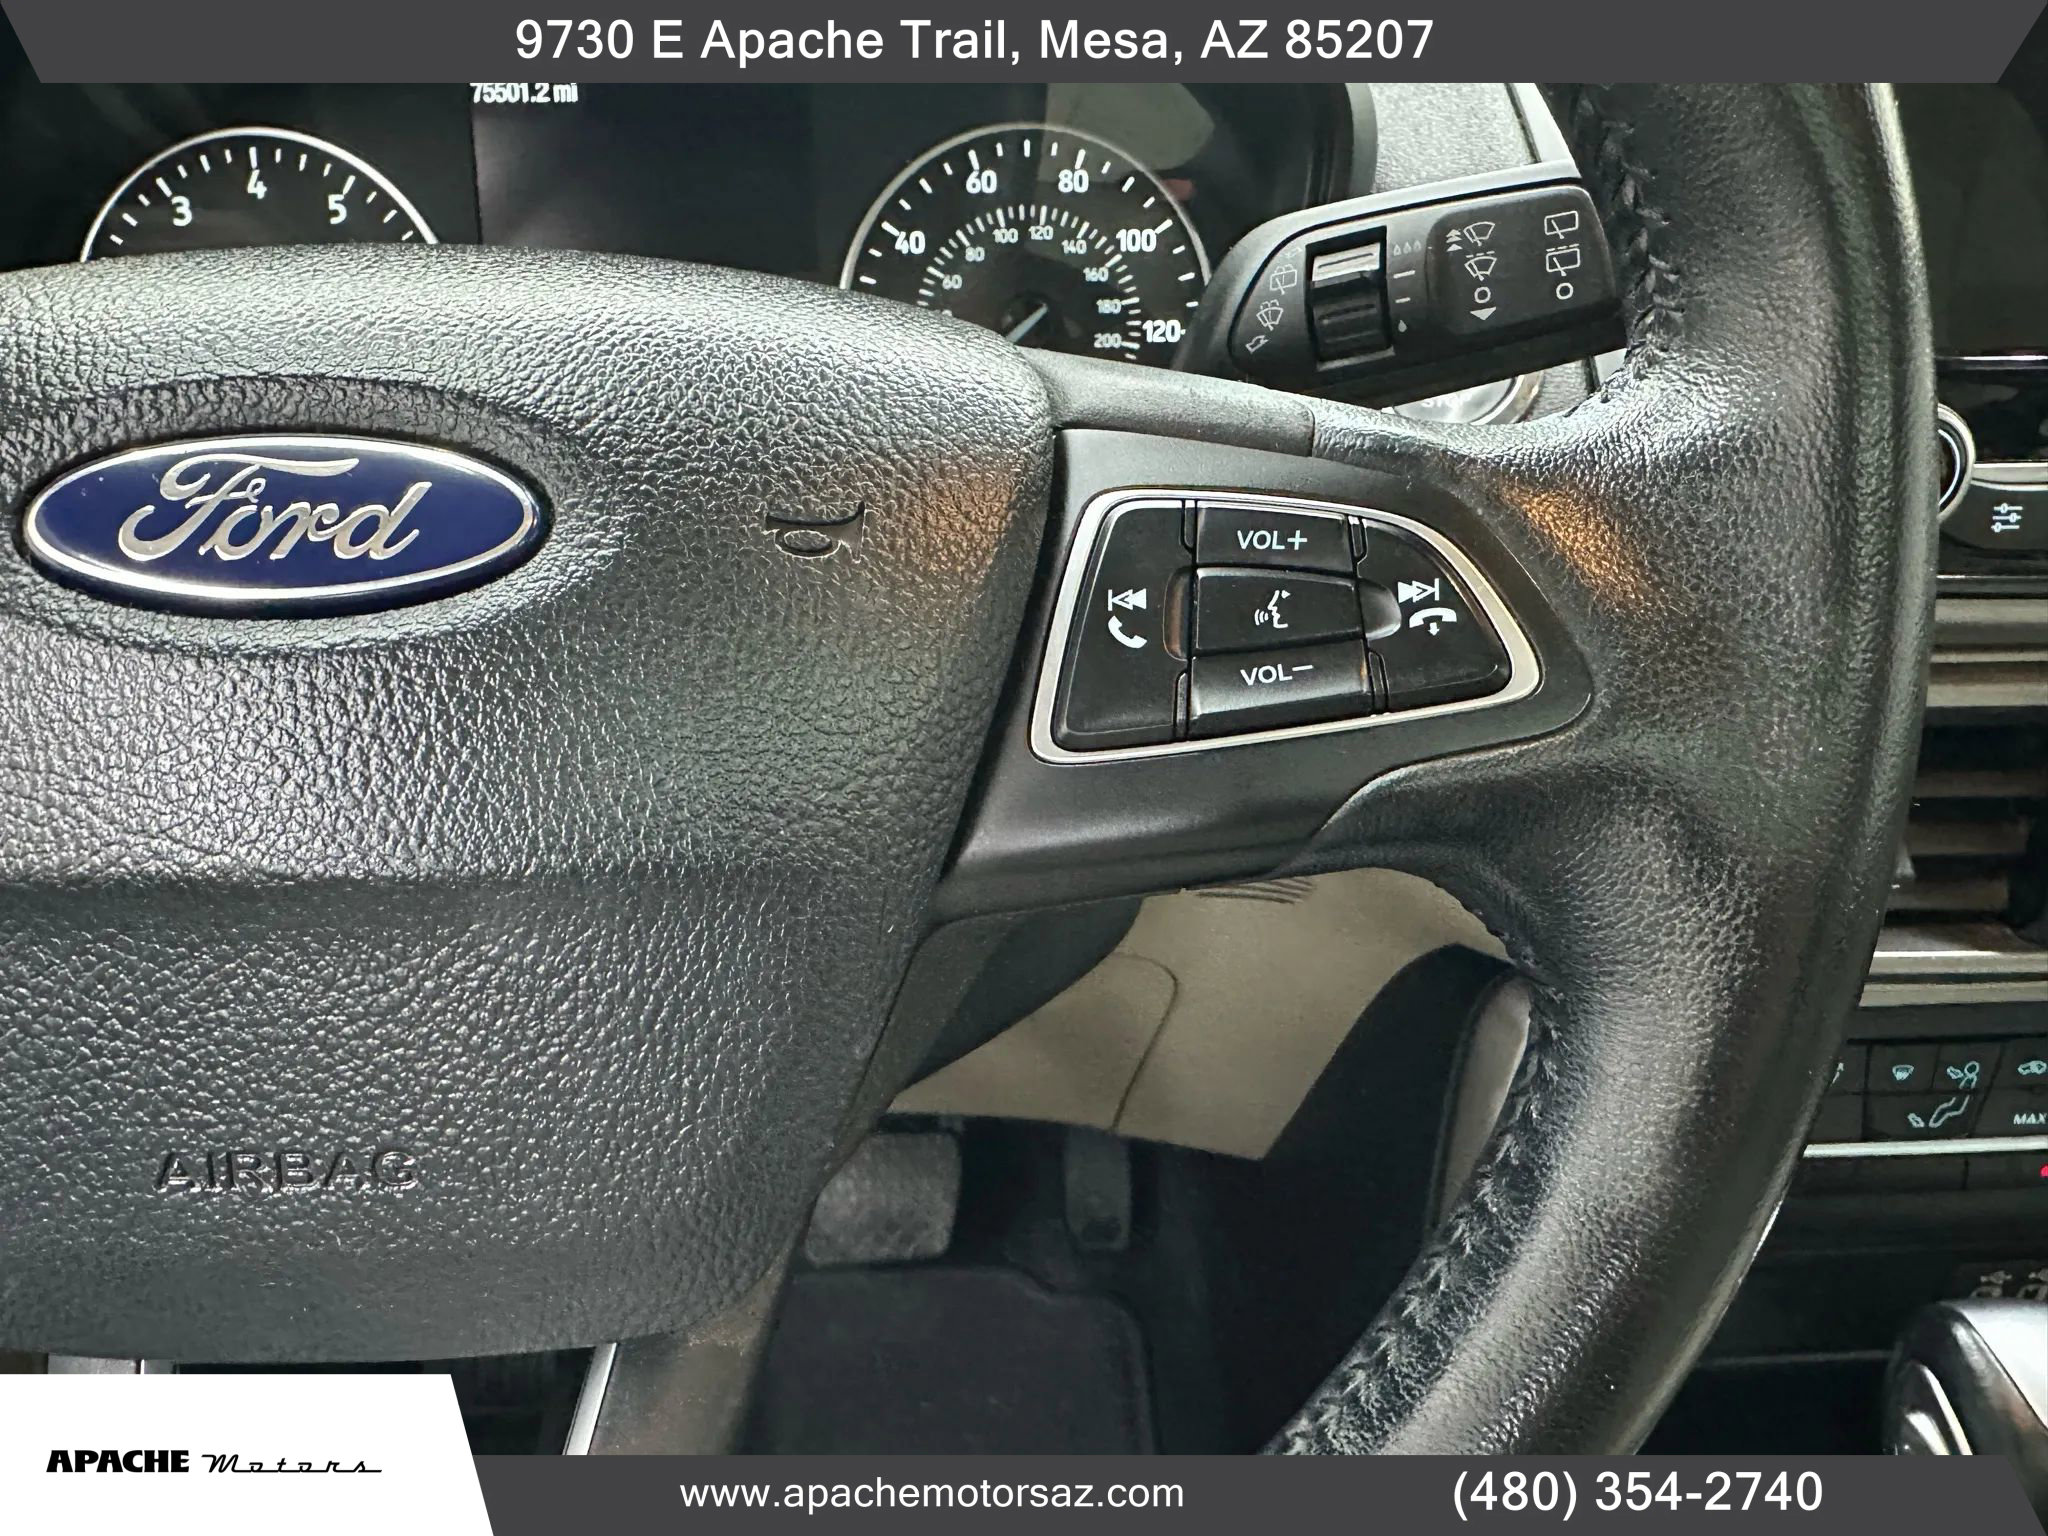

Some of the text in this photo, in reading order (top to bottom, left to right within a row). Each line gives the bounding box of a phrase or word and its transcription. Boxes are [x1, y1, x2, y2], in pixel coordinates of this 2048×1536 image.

[469, 82, 579, 104] 75501.2 mi
[247, 170, 267, 199] 4
[966, 170, 997, 193] 60
[1058, 170, 1088, 193] 80
[171, 196, 192, 226] 3
[328, 193, 347, 224] 5
[895, 230, 925, 254] 40
[992, 228, 1019, 244] 100
[1028, 225, 1054, 241] 120
[1115, 228, 1156, 252] 100
[965, 246, 985, 263] 80
[1061, 239, 1087, 255] 140
[943, 274, 963, 290] 60
[1083, 266, 1109, 283] 160
[1096, 299, 1122, 315] 180
[1094, 333, 1122, 349] 200
[1142, 319, 1181, 343] 120
[118, 453, 433, 562] Ford
[1237, 529, 1308, 551] VOL+
[156, 1149, 420, 1194] AIRBAG
